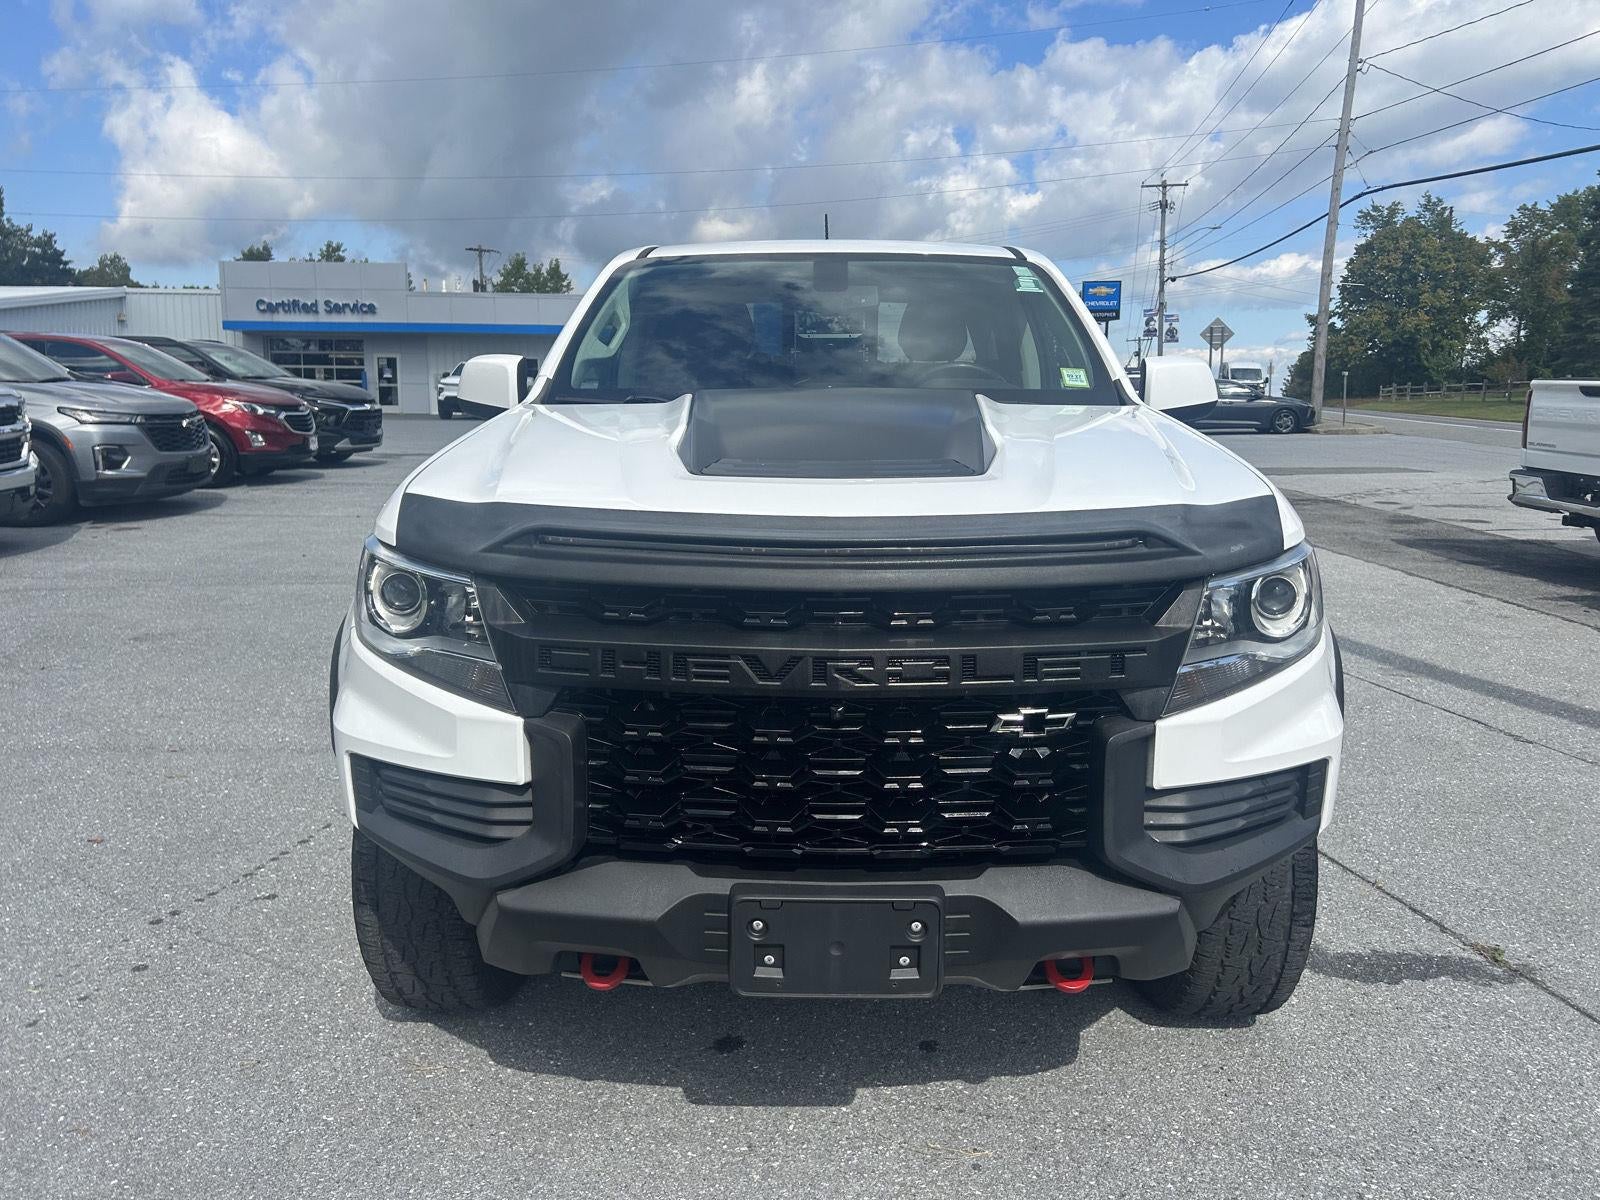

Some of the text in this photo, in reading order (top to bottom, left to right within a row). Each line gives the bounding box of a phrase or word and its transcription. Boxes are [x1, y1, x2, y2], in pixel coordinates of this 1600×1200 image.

[256, 298, 377, 314] Certified Service
[537, 648, 1148, 688] CHEVROLET
